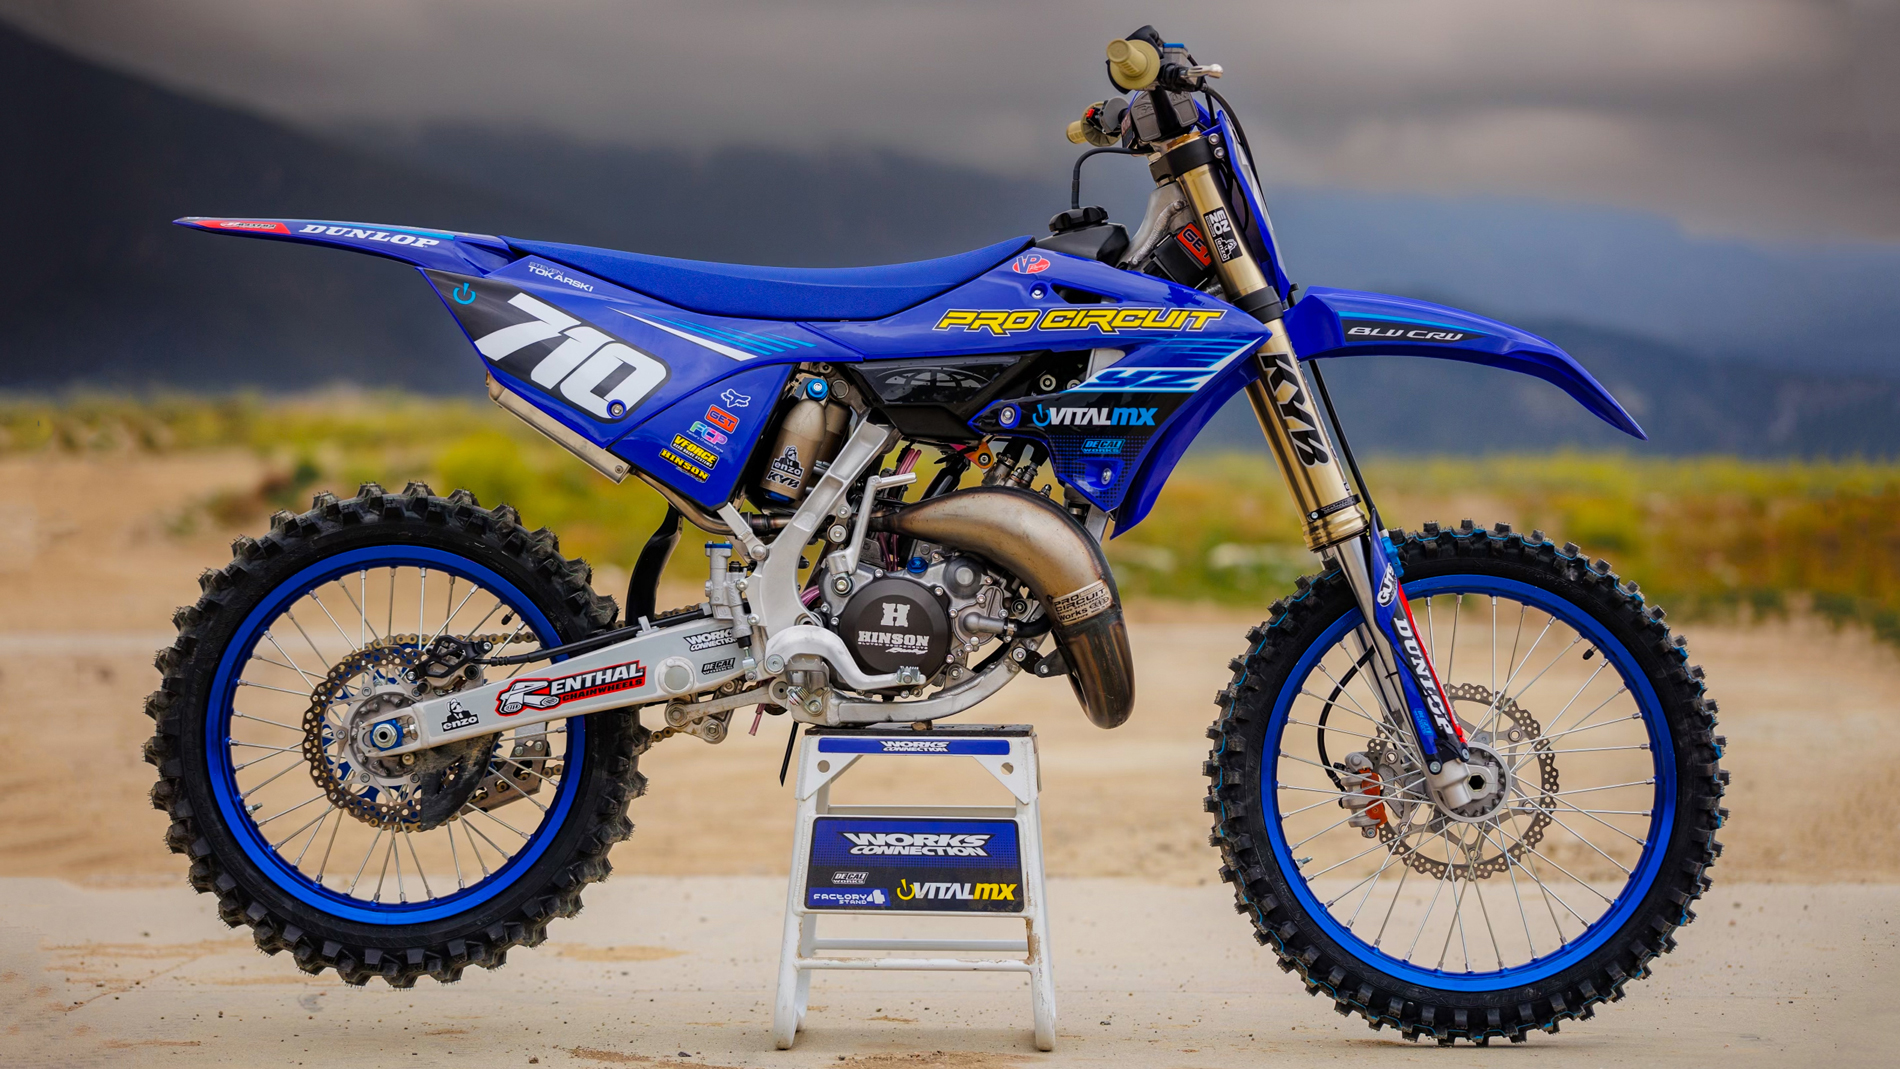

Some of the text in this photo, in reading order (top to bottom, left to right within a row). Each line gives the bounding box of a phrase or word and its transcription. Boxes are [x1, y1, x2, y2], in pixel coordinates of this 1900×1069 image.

[298, 224, 440, 248] DUNLOP
[1182, 227, 1209, 258] GE
[1216, 239, 1228, 259] enzo
[528, 261, 565, 276] STEVEN
[1016, 254, 1043, 274] VP
[528, 265, 594, 292] TOKARSKI
[933, 307, 1227, 336] PRO CIRCUIT
[1347, 326, 1464, 341] BLU CRU
[474, 292, 669, 419] 710
[1079, 369, 1218, 389] YZ
[709, 409, 735, 428] GET
[1257, 352, 1331, 469] KYB
[689, 420, 728, 445] FCP
[673, 435, 718, 464] VFORCE
[1085, 440, 1122, 449] DECAL
[660, 449, 709, 480] HINSON
[774, 460, 802, 476] enzo
[767, 470, 801, 489] KYB
[1054, 594, 1079, 607] PRO
[1055, 588, 1105, 612] CIRCUIT
[880, 602, 910, 628] H
[1058, 608, 1088, 621] Works
[858, 630, 930, 647] HINSON
[1393, 617, 1454, 735] DUNLOP
[563, 678, 643, 701] CHAINWHEELS
[442, 716, 478, 731] enzo
[880, 740, 950, 748] WORKS
[843, 833, 991, 847] WORKS
[850, 845, 988, 857] CONNECTION
